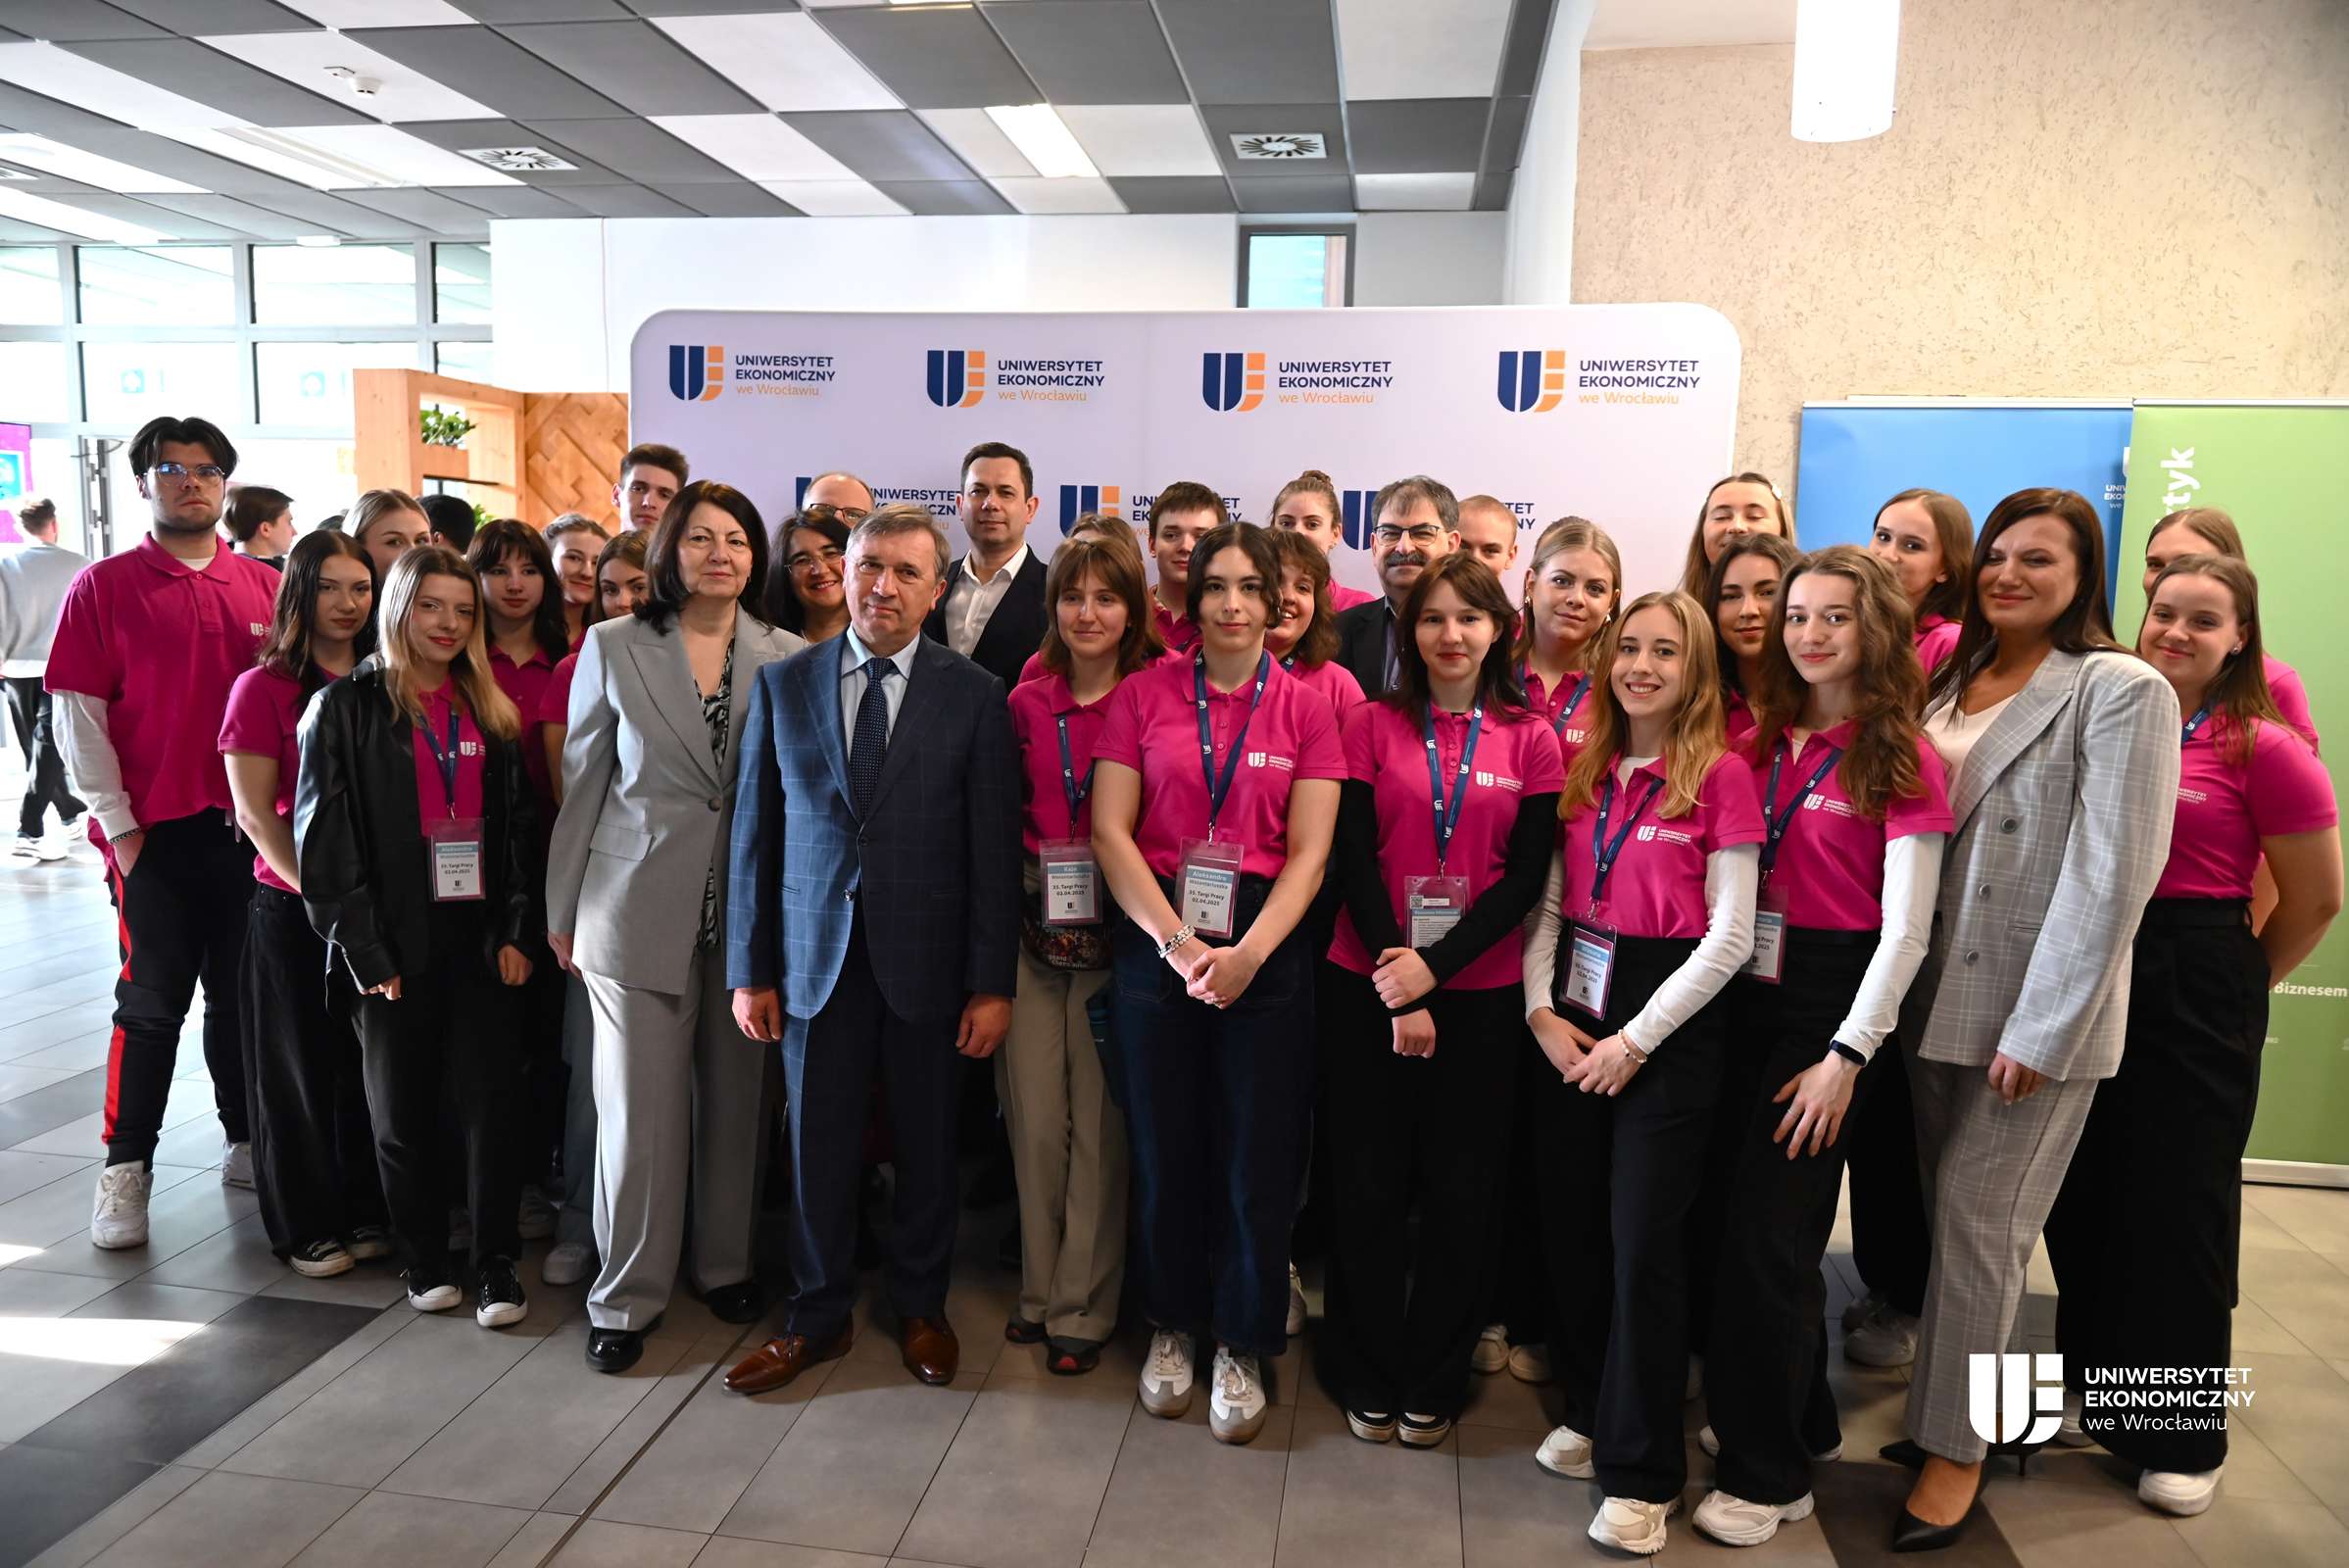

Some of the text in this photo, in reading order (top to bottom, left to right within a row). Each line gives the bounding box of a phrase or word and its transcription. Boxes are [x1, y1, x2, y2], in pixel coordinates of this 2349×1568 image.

[735, 355, 834, 368] UNIWERSYTET
[998, 360, 1103, 372] UNIWERSYTET
[1279, 362, 1392, 373] UNIWERSYTET
[1579, 360, 1699, 372] UNIWERSYTET
[735, 369, 836, 382] EKONOMICZNY
[998, 374, 1105, 387] EKONOMICZNY
[1278, 376, 1394, 388] EKONOMICZNY
[1579, 375, 1701, 388] EKONOMICZNY
[736, 383, 820, 397] we Wrocławiu
[998, 389, 1088, 402] we Wrocławiu
[1279, 392, 1374, 404] we Wrocławiu
[1579, 392, 1680, 405] we Wrocławiu
[870, 487, 961, 502] NIWERSYTE
[2275, 981, 2348, 997] Biznesem
